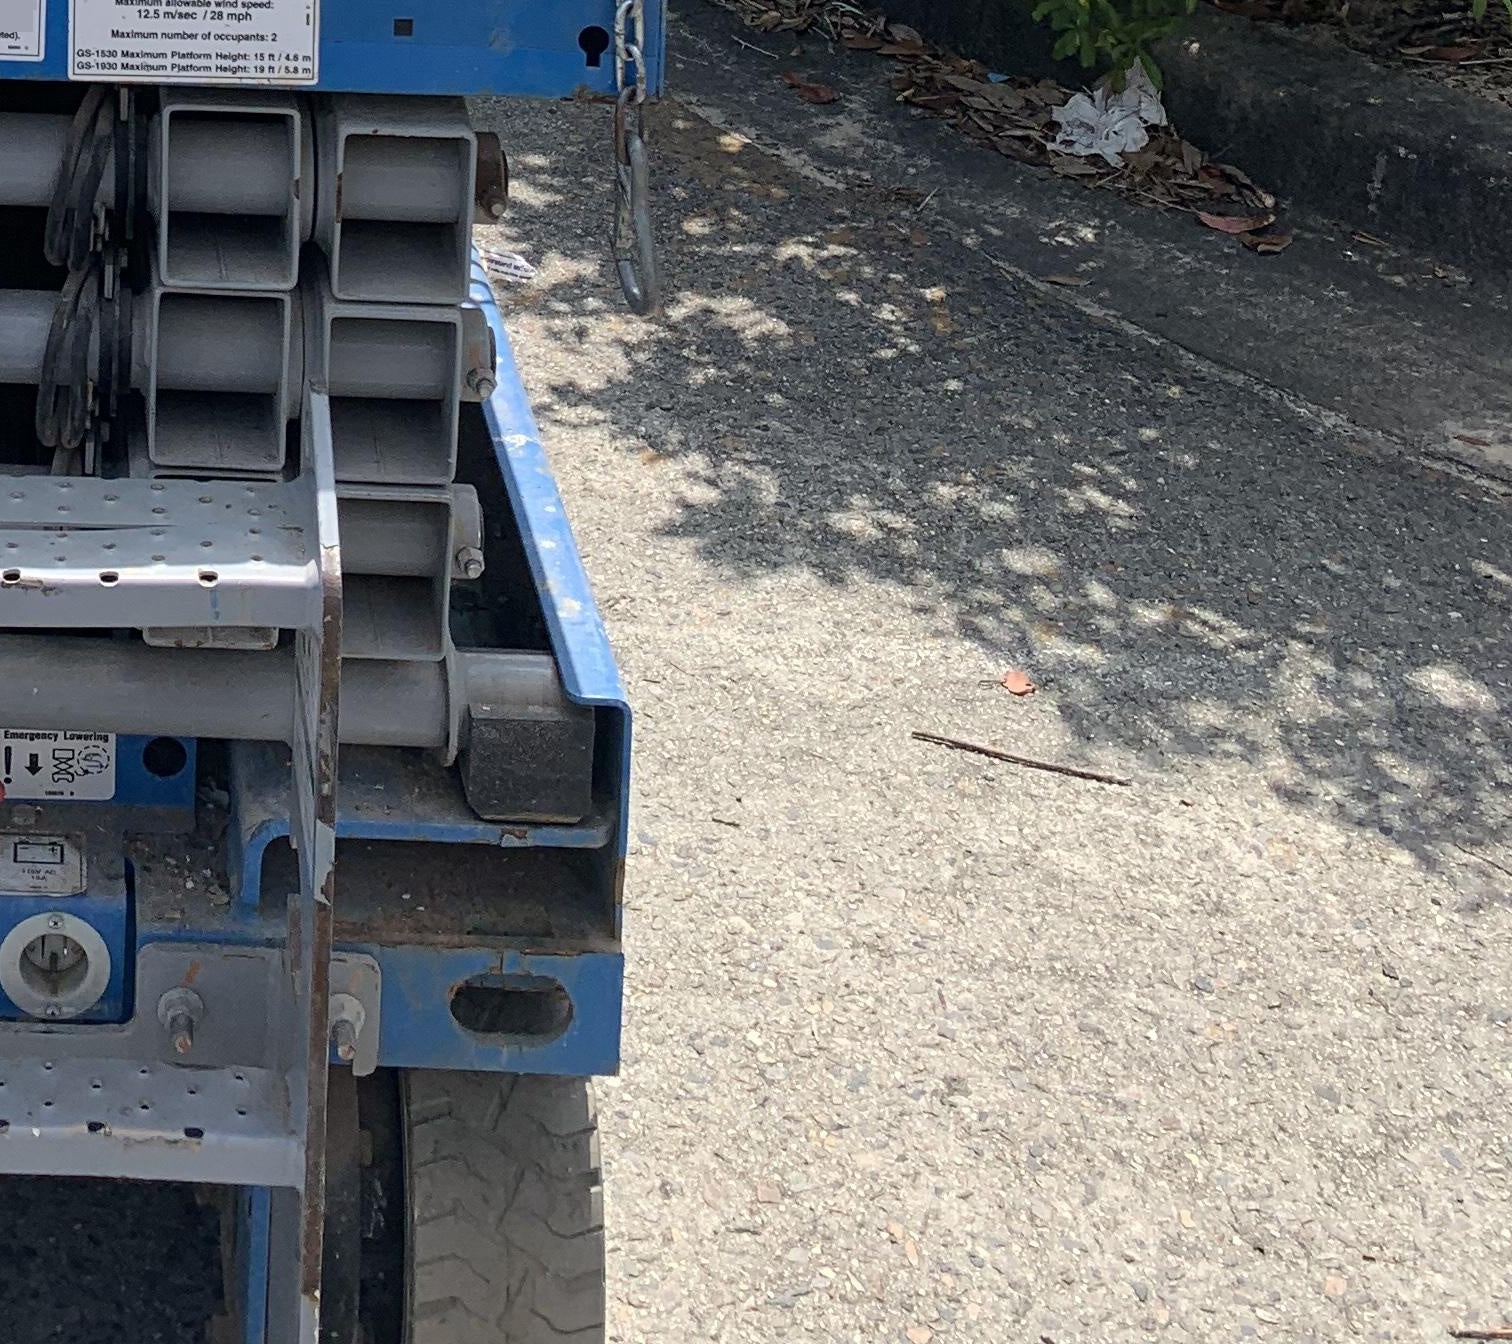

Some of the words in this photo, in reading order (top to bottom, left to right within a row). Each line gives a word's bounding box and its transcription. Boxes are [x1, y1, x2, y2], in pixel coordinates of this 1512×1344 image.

[214, 0, 238, 8] wind
[241, 0, 274, 11] speed:
[137, 9, 160, 19] 12.5
[163, 10, 197, 20] m/sec
[210, 11, 223, 20] 28
[227, 11, 252, 23] mph
[111, 29, 158, 39] Maximum
[161, 30, 198, 40] number
[201, 32, 211, 41] of
[214, 33, 268, 43] occupants:
[271, 33, 278, 42] 2
[77, 49, 118, 58] GS-1530
[121, 50, 167, 59] Maximum
[171, 51, 212, 60] Platform
[216, 52, 250, 62] Height:
[254, 53, 264, 61] 15
[268, 53, 275, 61] ft
[77, 61, 118, 70] GS-1930
[121, 62, 167, 71] Maximum
[171, 63, 212, 72] Platform
[216, 64, 250, 74] Height:
[254, 65, 264, 73] 19
[268, 65, 275, 73] ft
[4, 731, 59, 742] Emergency
[63, 731, 109, 743] Lowering
